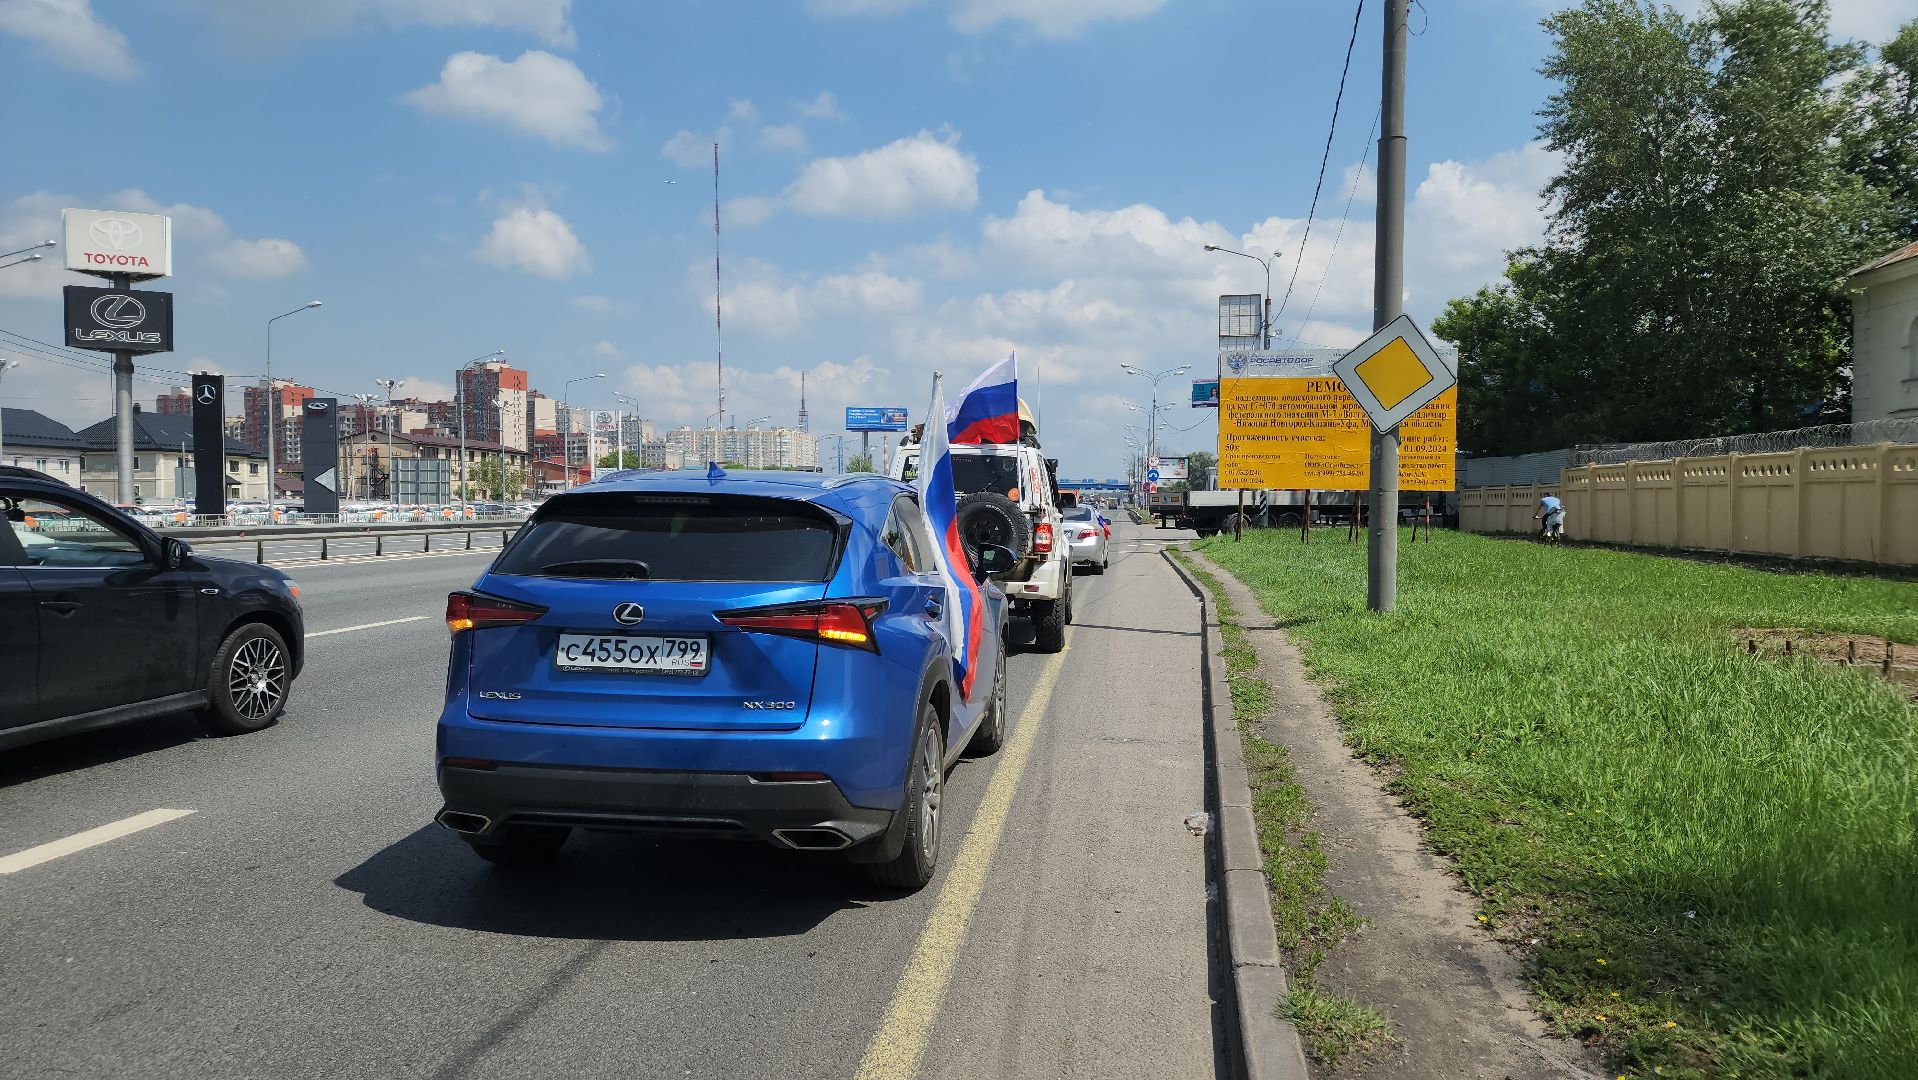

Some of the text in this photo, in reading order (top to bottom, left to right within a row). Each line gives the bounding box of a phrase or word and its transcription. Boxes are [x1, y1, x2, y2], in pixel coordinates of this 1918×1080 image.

[84, 253, 149, 267] TOYOTA
[75, 328, 161, 344] LEXUS
[1306, 381, 1347, 392] РЕМО
[1333, 394, 1354, 402] пере
[1278, 402, 1338, 410] автомобильной
[1228, 410, 1281, 419] федерального
[1411, 420, 1442, 428] область
[1226, 433, 1289, 441] Протяженность
[1404, 444, 1447, 453] 01.09.2024
[566, 638, 700, 664] С455ОХ 799
[672, 659, 690, 667] RUS
[479, 690, 521, 700] LEXUS
